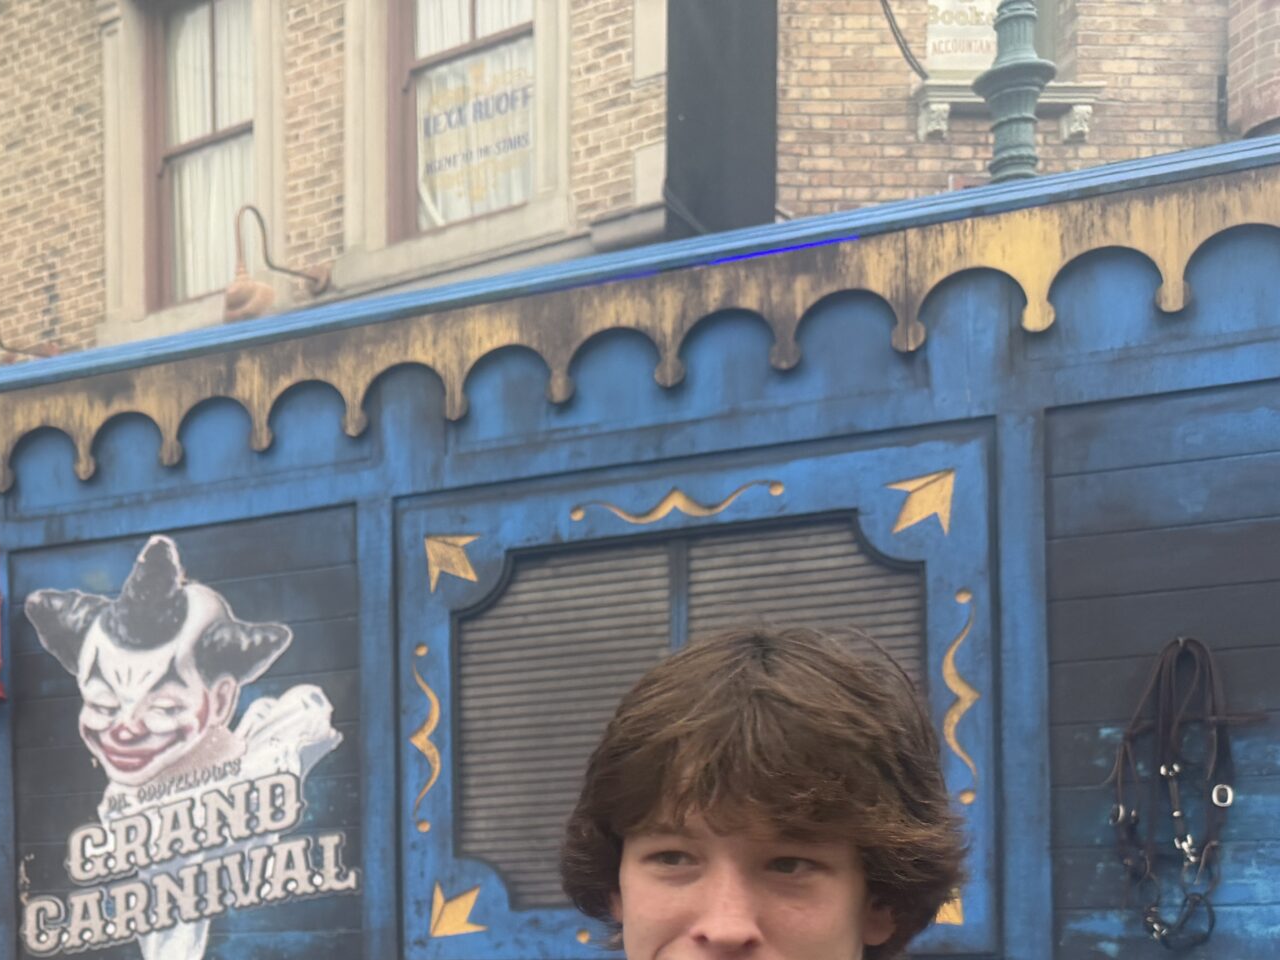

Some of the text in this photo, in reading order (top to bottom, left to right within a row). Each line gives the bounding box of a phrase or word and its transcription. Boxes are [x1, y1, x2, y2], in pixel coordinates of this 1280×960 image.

[931, 39, 995, 56] ACCOUNTAN
[66, 771, 304, 886] GRAND
[23, 833, 360, 956] CARNIVAL
